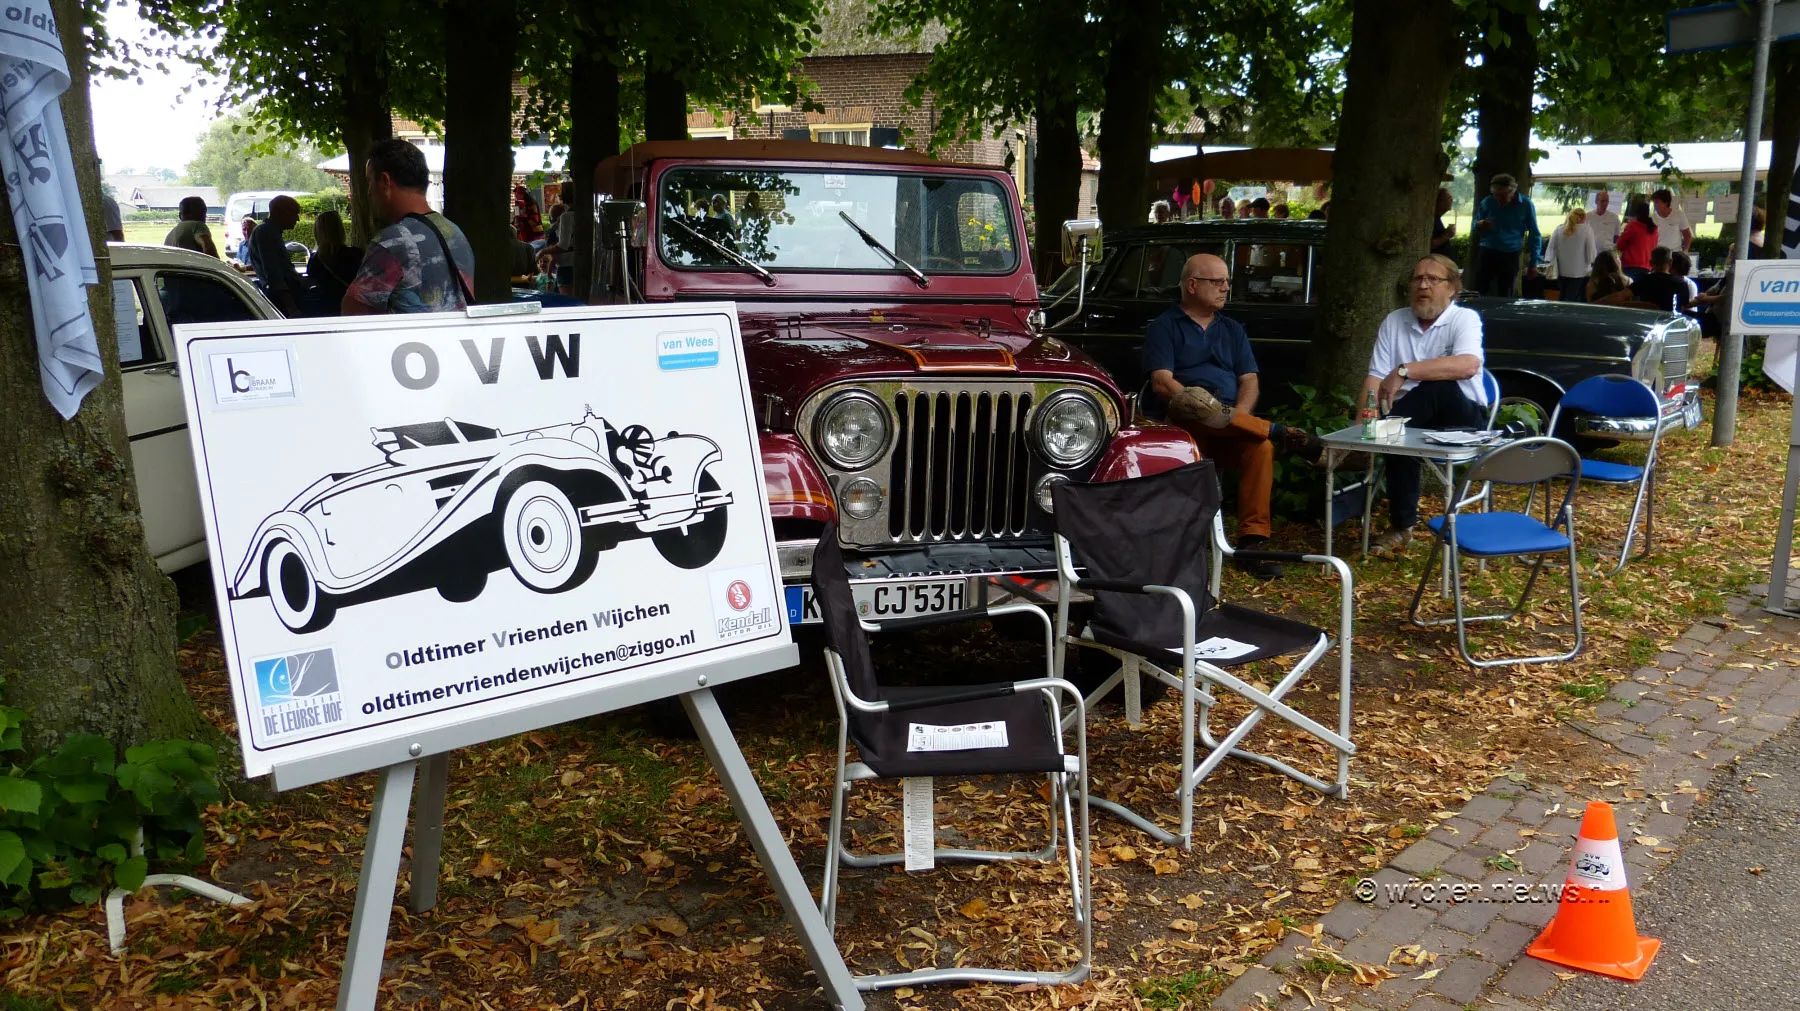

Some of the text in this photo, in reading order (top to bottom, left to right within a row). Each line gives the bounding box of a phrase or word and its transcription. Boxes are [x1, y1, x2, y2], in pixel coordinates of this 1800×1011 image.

[1760, 280, 1800, 293] van
[663, 336, 714, 350] van Wees
[914, 583, 964, 612] 53H
[718, 607, 769, 633] Kendall
[720, 628, 751, 638] MOTOR
[386, 601, 670, 669] Oldtimer Vrienden Wijchen
[362, 630, 695, 715] oldtimervriendenwijchen@ziggo.nl
[263, 700, 343, 736] DE LEURSE HOF
